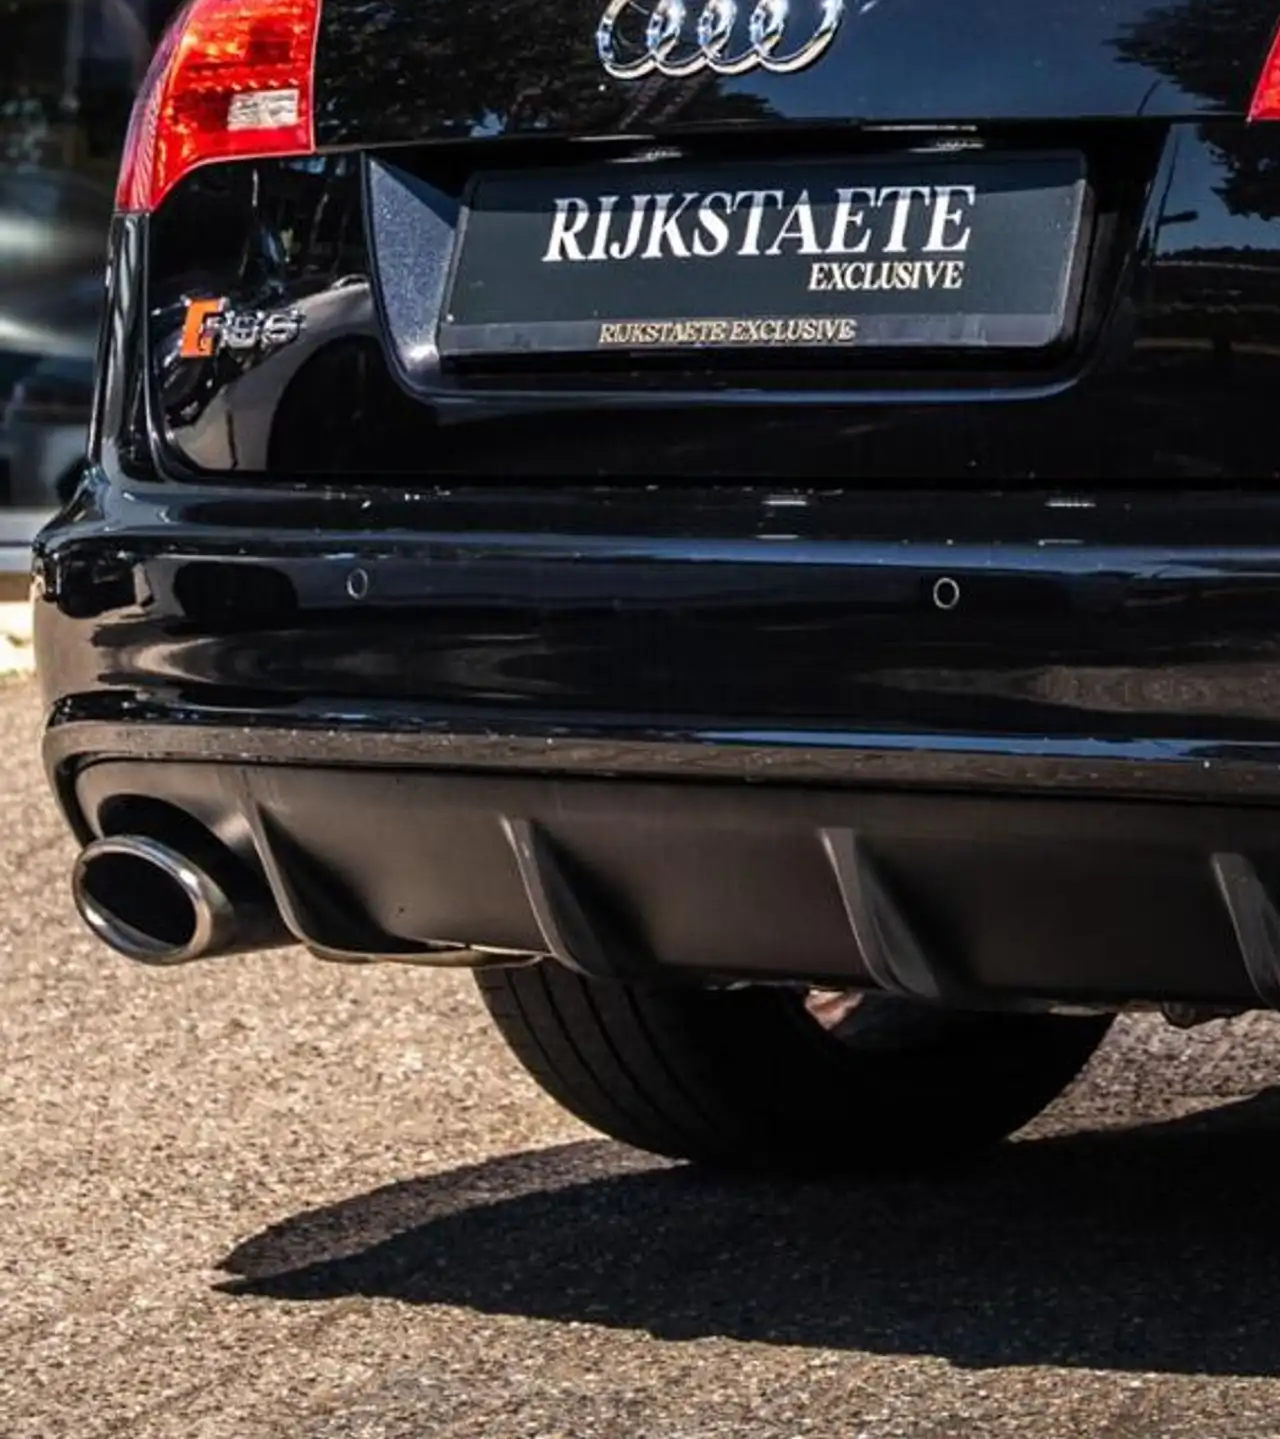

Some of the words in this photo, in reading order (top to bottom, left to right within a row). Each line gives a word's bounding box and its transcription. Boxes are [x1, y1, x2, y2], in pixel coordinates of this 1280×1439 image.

[542, 184, 976, 262] RIJKSTAETE
[807, 261, 964, 291] EXCLUSIVE
[599, 321, 727, 343] RIJKSTAETE
[729, 318, 857, 342] EXCLUSIVE
